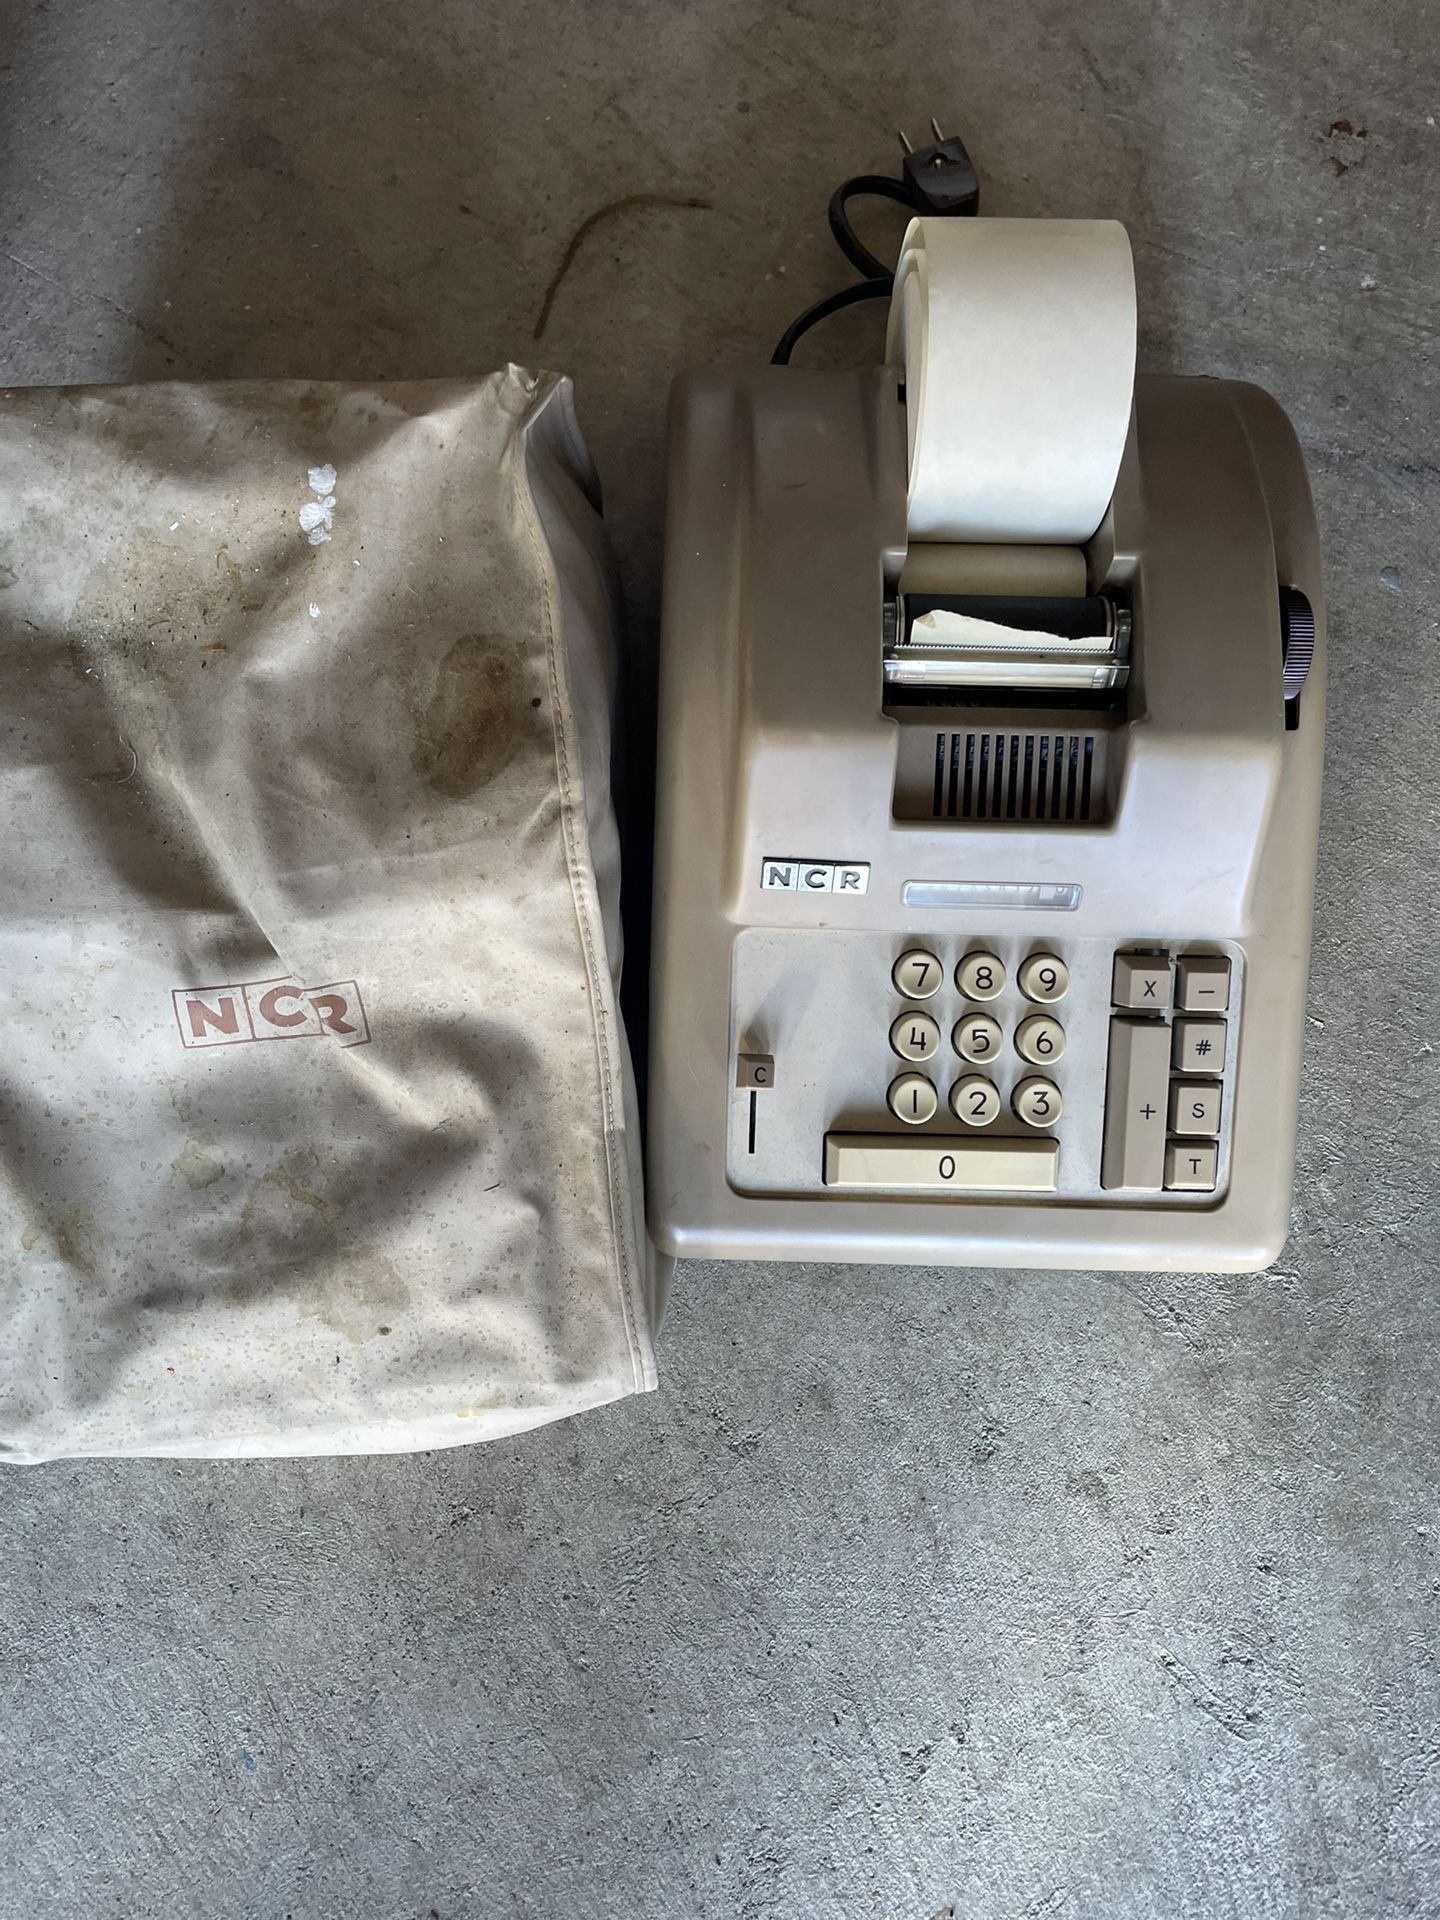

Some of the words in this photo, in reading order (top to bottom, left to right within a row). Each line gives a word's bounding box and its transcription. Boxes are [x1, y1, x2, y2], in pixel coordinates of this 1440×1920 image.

[769, 866, 860, 889] NCR
[912, 962, 930, 988] 7
[975, 966, 993, 990] 8
[1039, 968, 1057, 993] 9
[185, 985, 358, 1037] NCR
[909, 1026, 927, 1051] 4
[972, 1029, 990, 1054] 5
[1036, 1030, 1054, 1055] 6
[1195, 1039, 1212, 1056] #
[754, 1066, 767, 1084] C
[969, 1091, 987, 1116] 2
[1032, 1091, 1050, 1116] 3
[1139, 1103, 1157, 1120] +
[1191, 1102, 1205, 1119] S
[938, 1155, 956, 1180] 0
[1188, 1158, 1202, 1175] T
